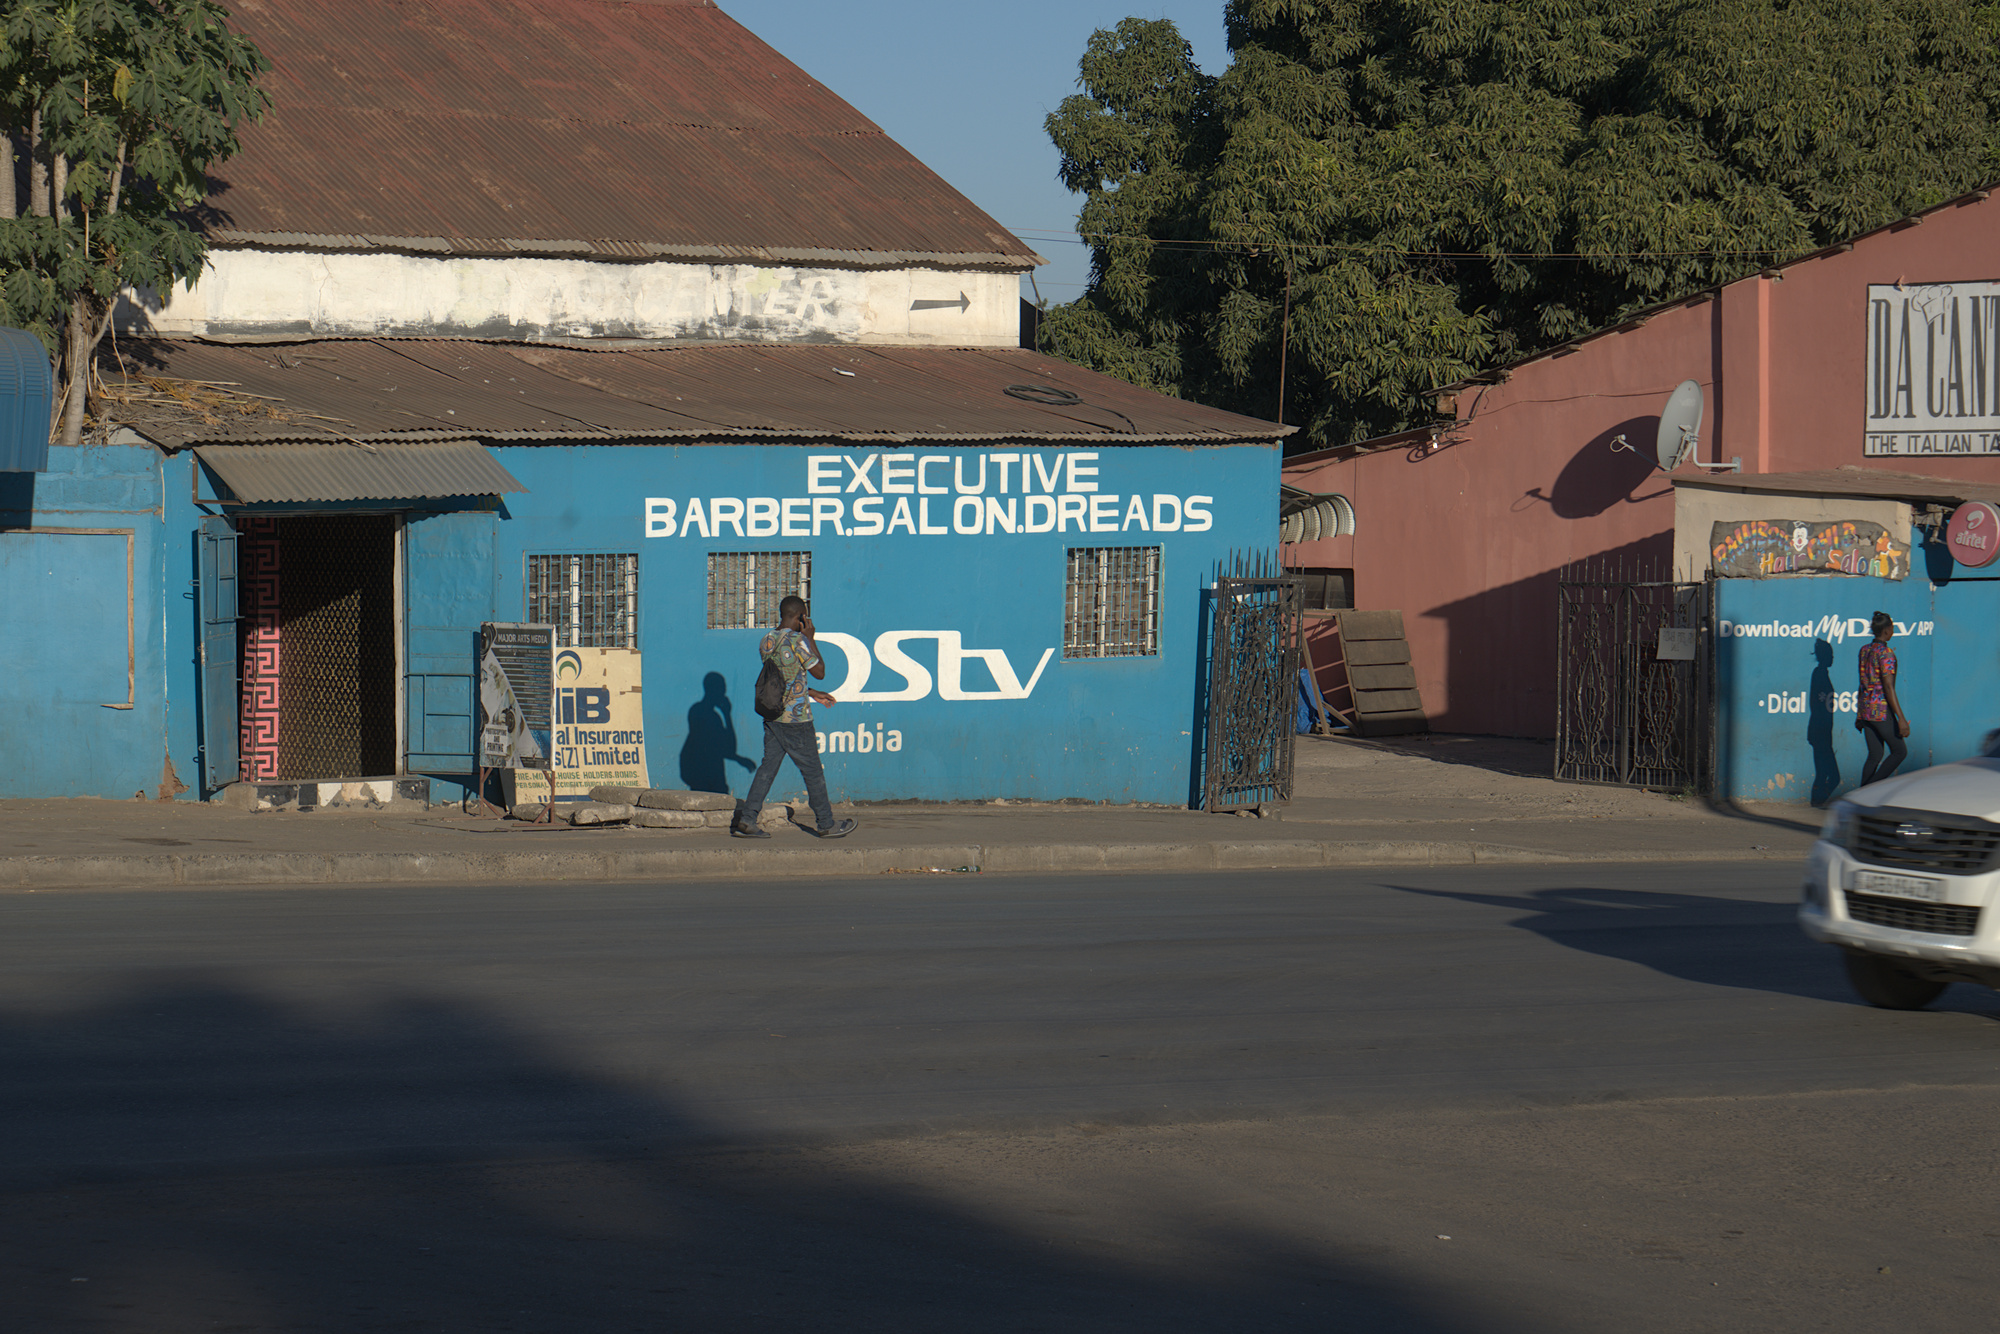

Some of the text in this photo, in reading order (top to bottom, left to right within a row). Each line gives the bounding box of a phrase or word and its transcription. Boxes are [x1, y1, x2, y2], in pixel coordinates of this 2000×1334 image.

[1869, 297, 1917, 419] DA
[1869, 435, 1898, 453] THE
[1907, 434, 1972, 453] ITALIAN
[807, 452, 1100, 495] EXECUTIVE
[1955, 530, 1988, 551] airtel
[1759, 548, 1882, 577] Hair Salon
[497, 633, 548, 644] MAJOR ARTS MEDIA
[1719, 619, 1813, 638] Download
[1916, 620, 1935, 636] APP
[1767, 690, 1807, 714] Dial
[556, 726, 644, 746] al Insurance
[815, 722, 903, 754] ambia
[583, 746, 640, 766] Limited
